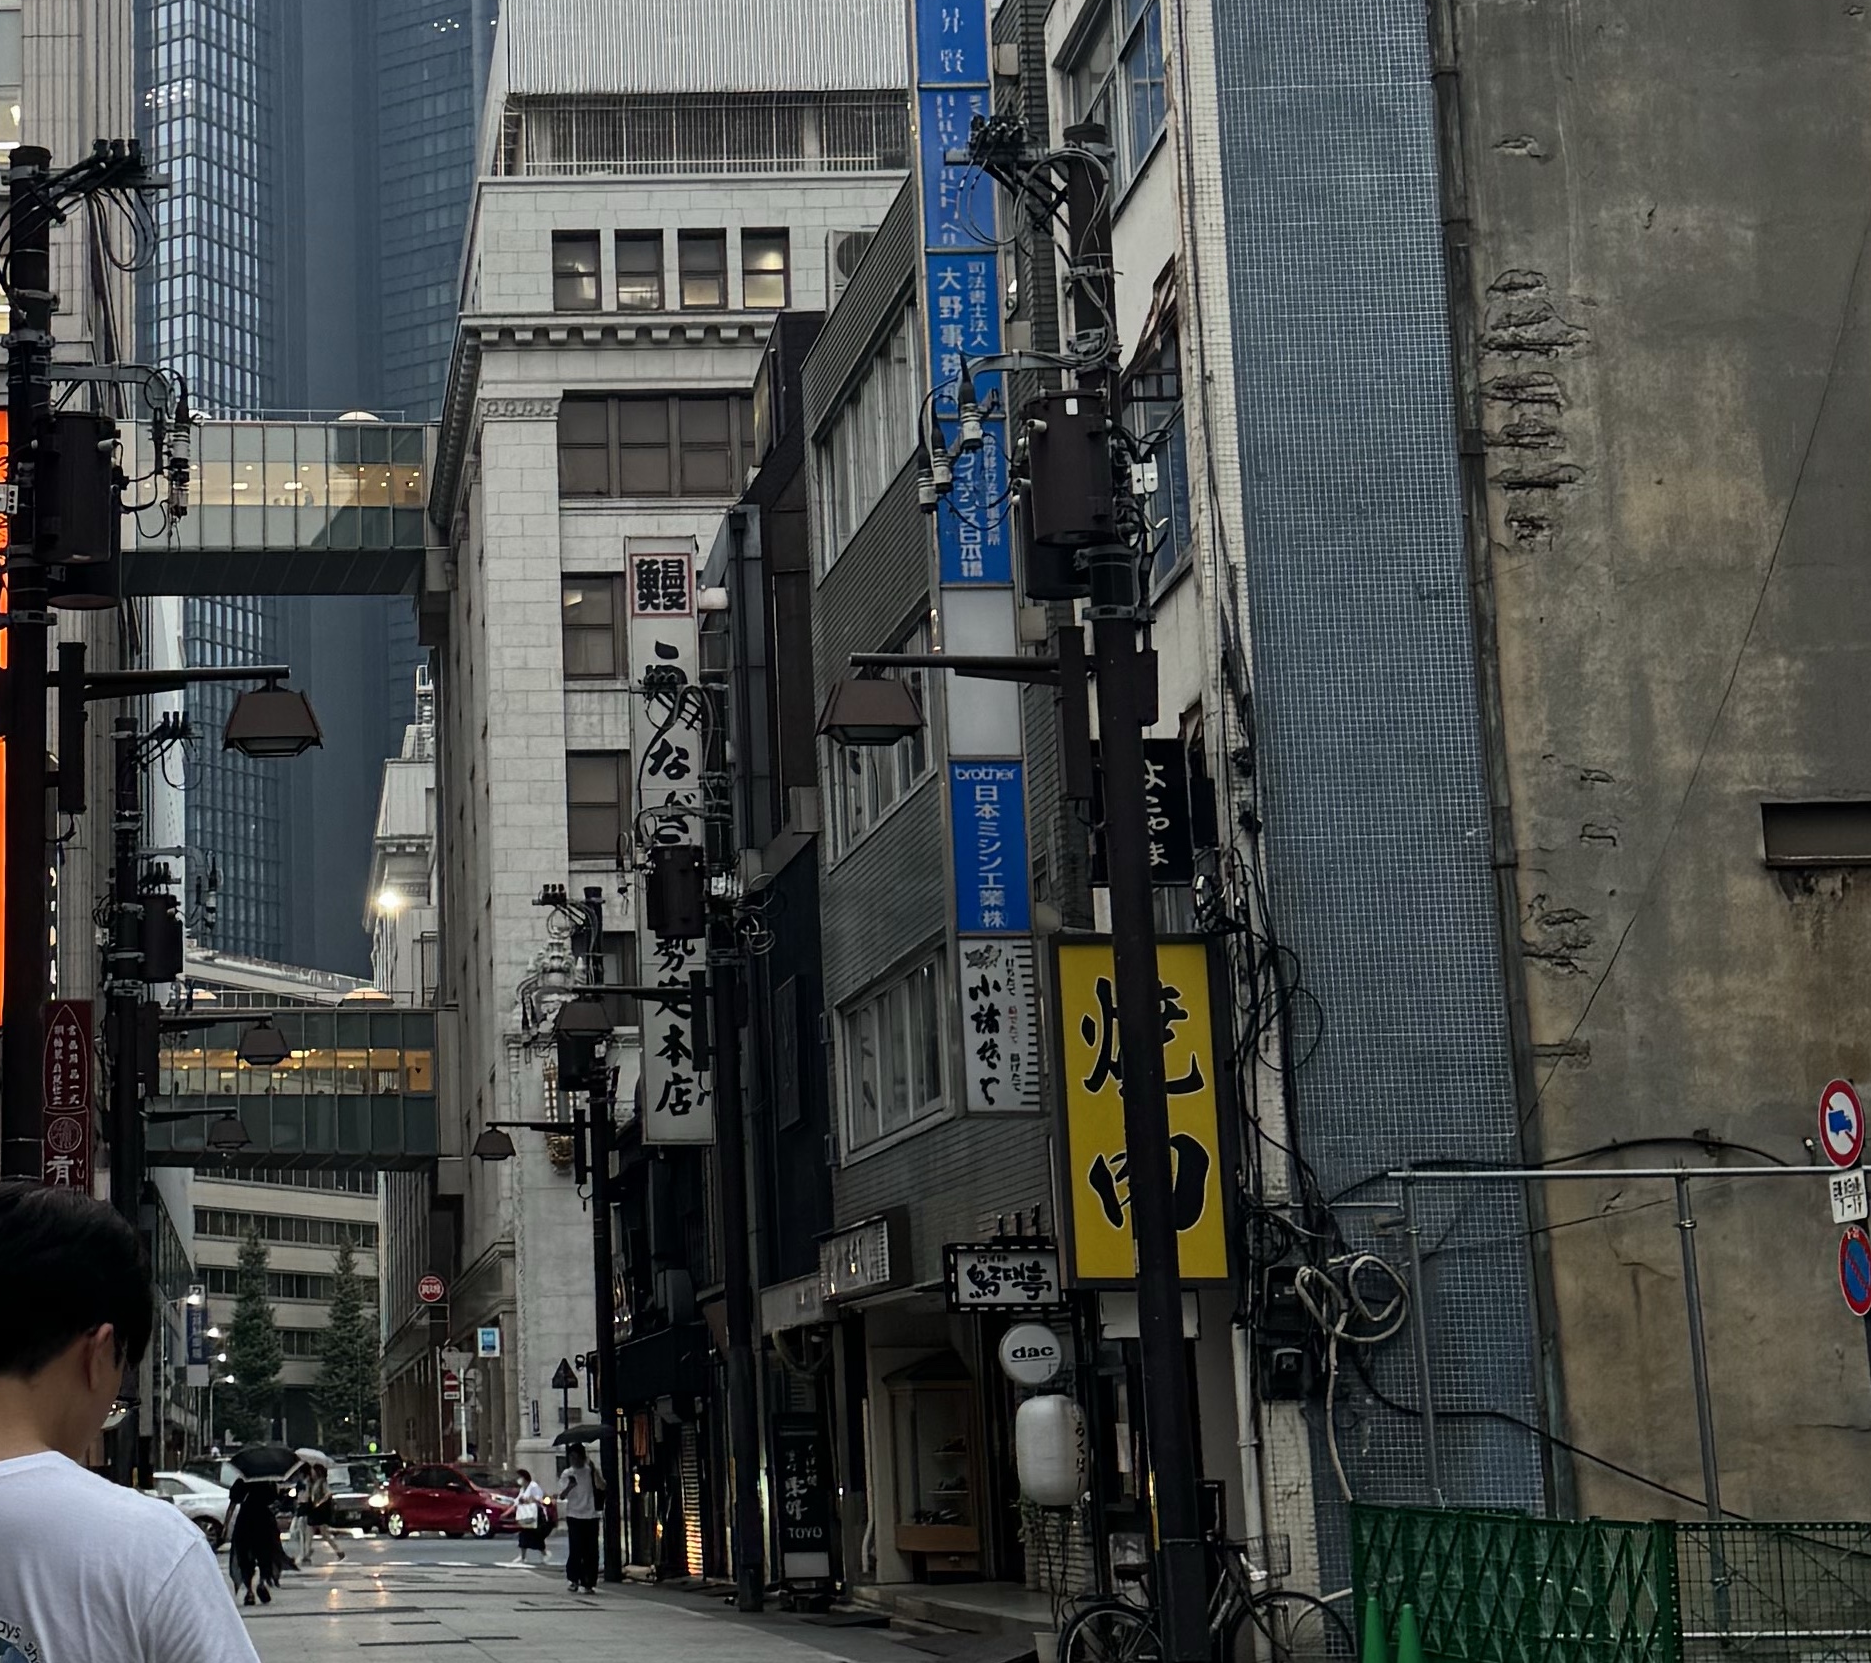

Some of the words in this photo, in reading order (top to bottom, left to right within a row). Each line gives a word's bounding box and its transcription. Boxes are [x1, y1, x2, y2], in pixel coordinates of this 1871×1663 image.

[635, 558, 687, 612] 鰻
[954, 766, 1018, 781] brother
[1011, 1345, 1055, 1360] dac
